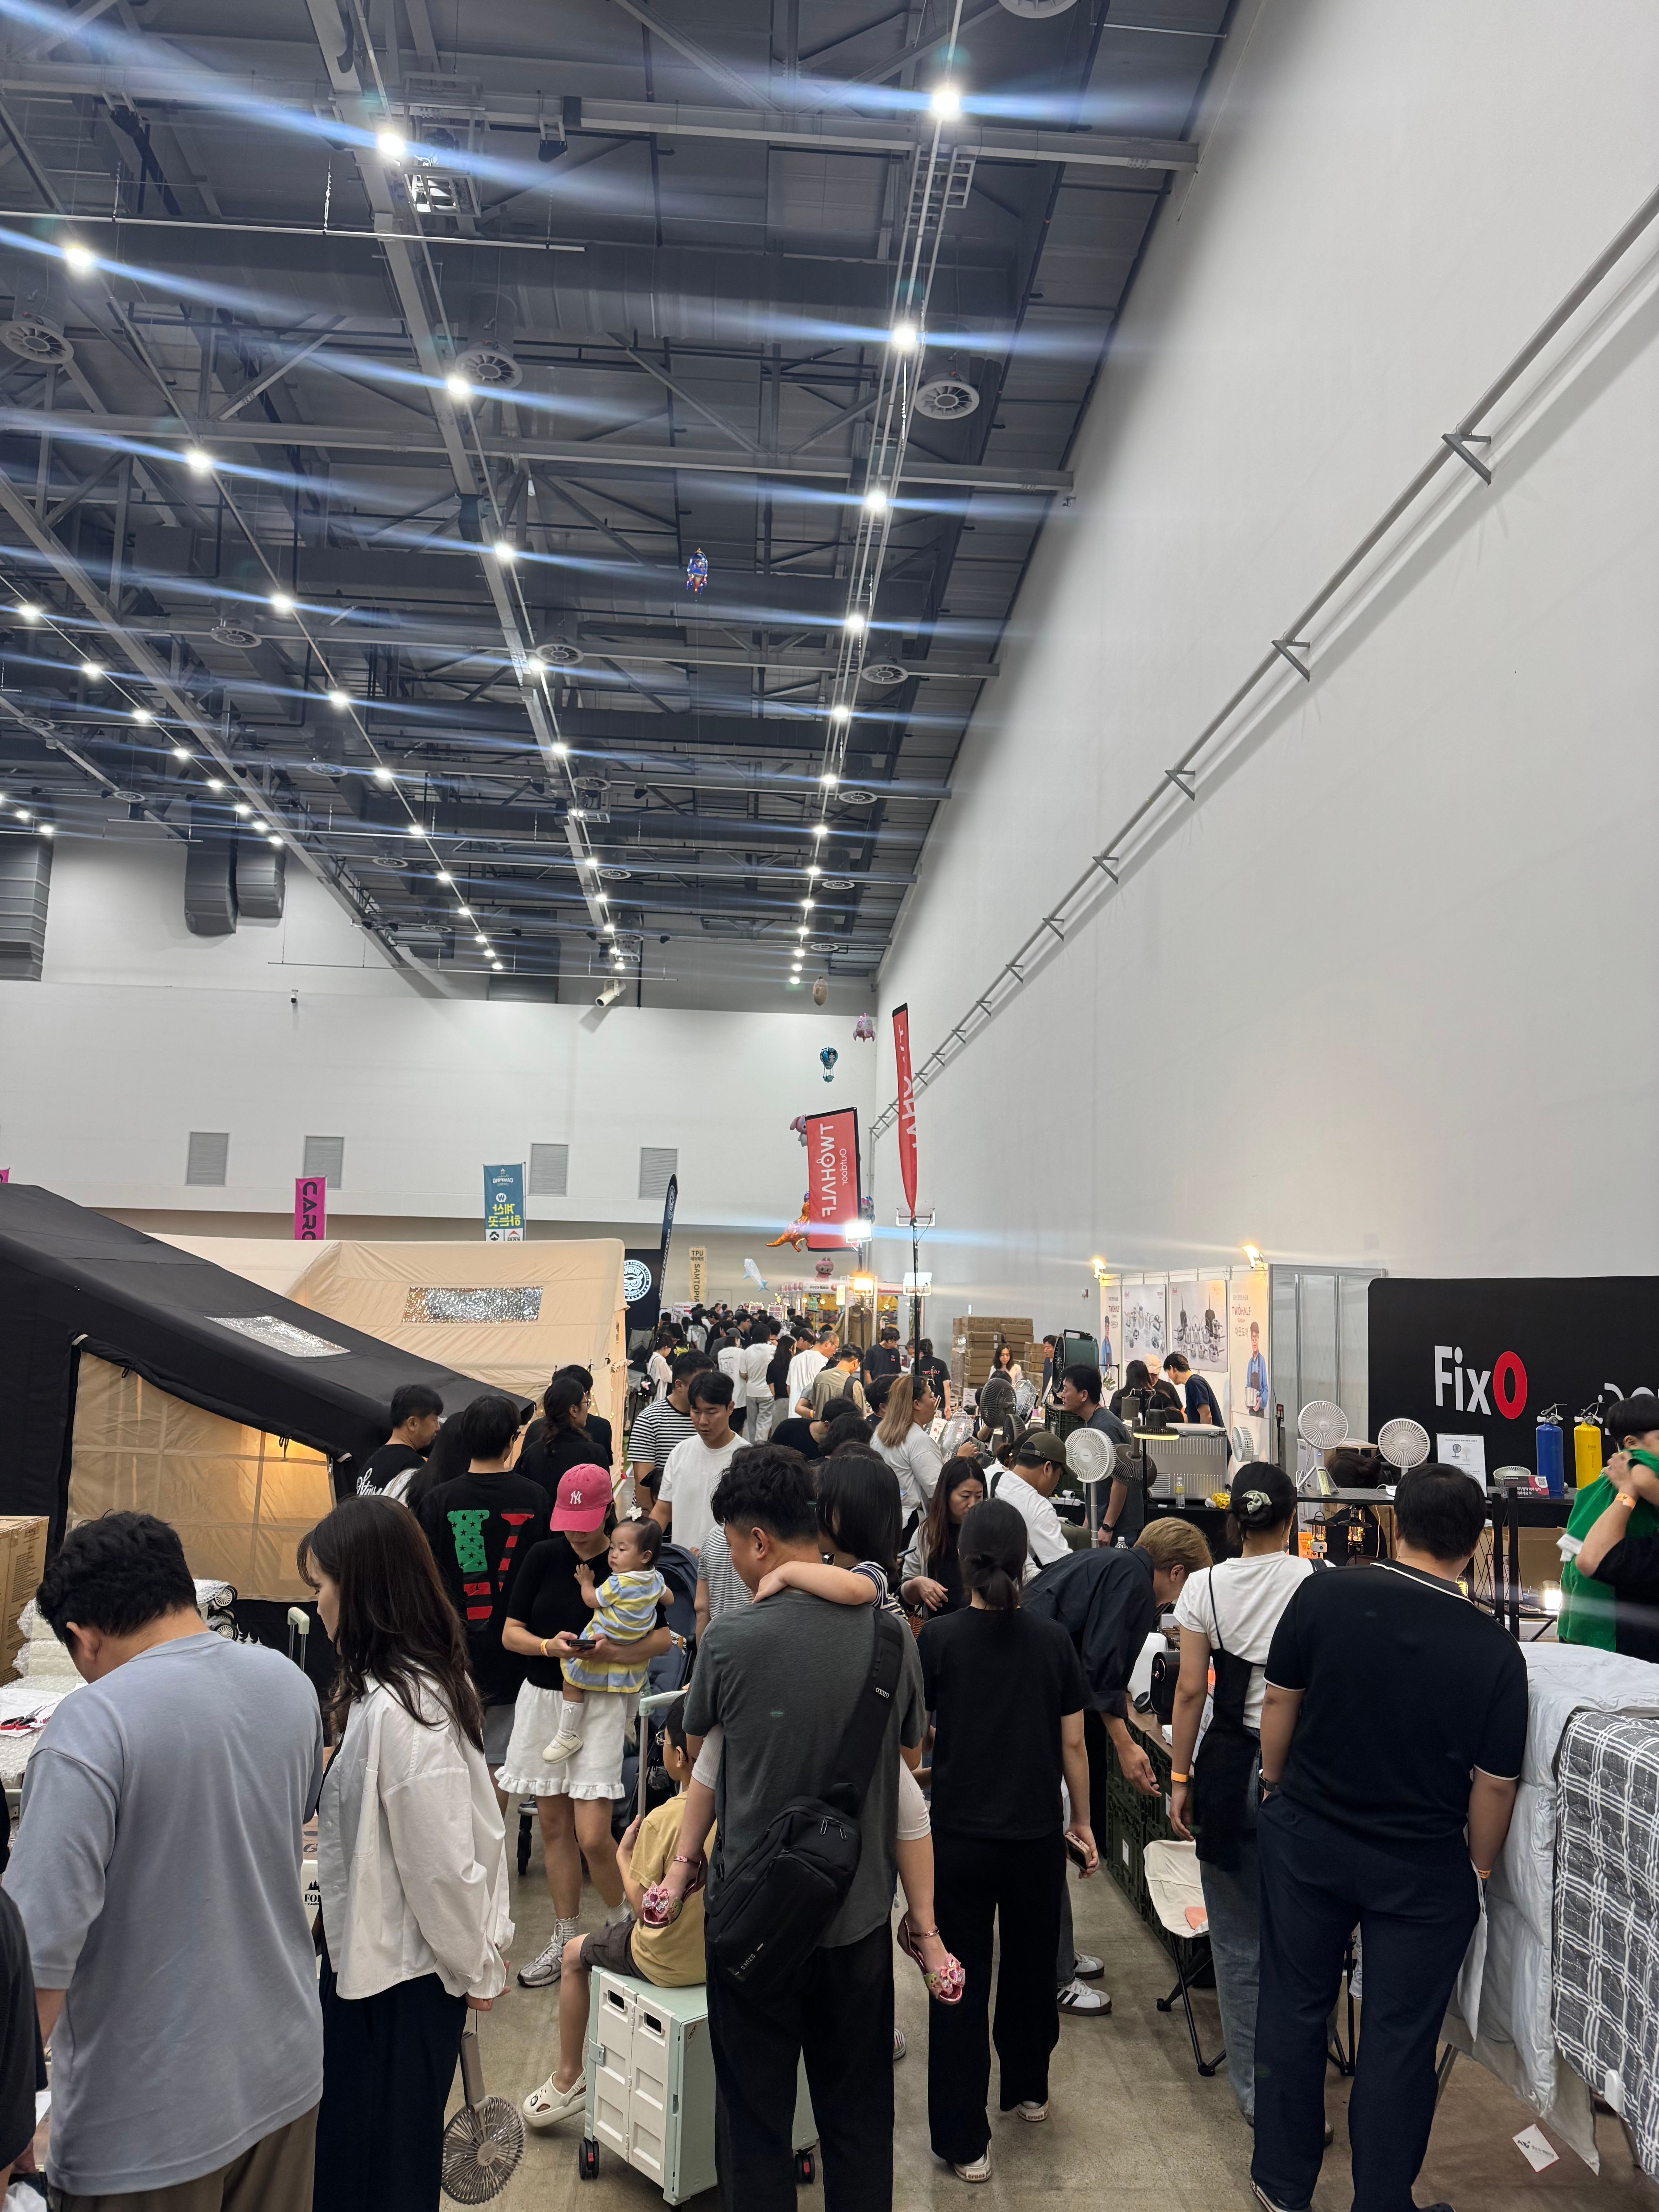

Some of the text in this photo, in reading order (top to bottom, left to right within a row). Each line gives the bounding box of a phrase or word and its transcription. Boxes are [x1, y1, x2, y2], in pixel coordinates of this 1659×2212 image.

[1231, 1305, 1251, 1316] TWOHALF
[1235, 1327, 1249, 1337] 아웃도어
[570, 1490, 582, 1504] NY
